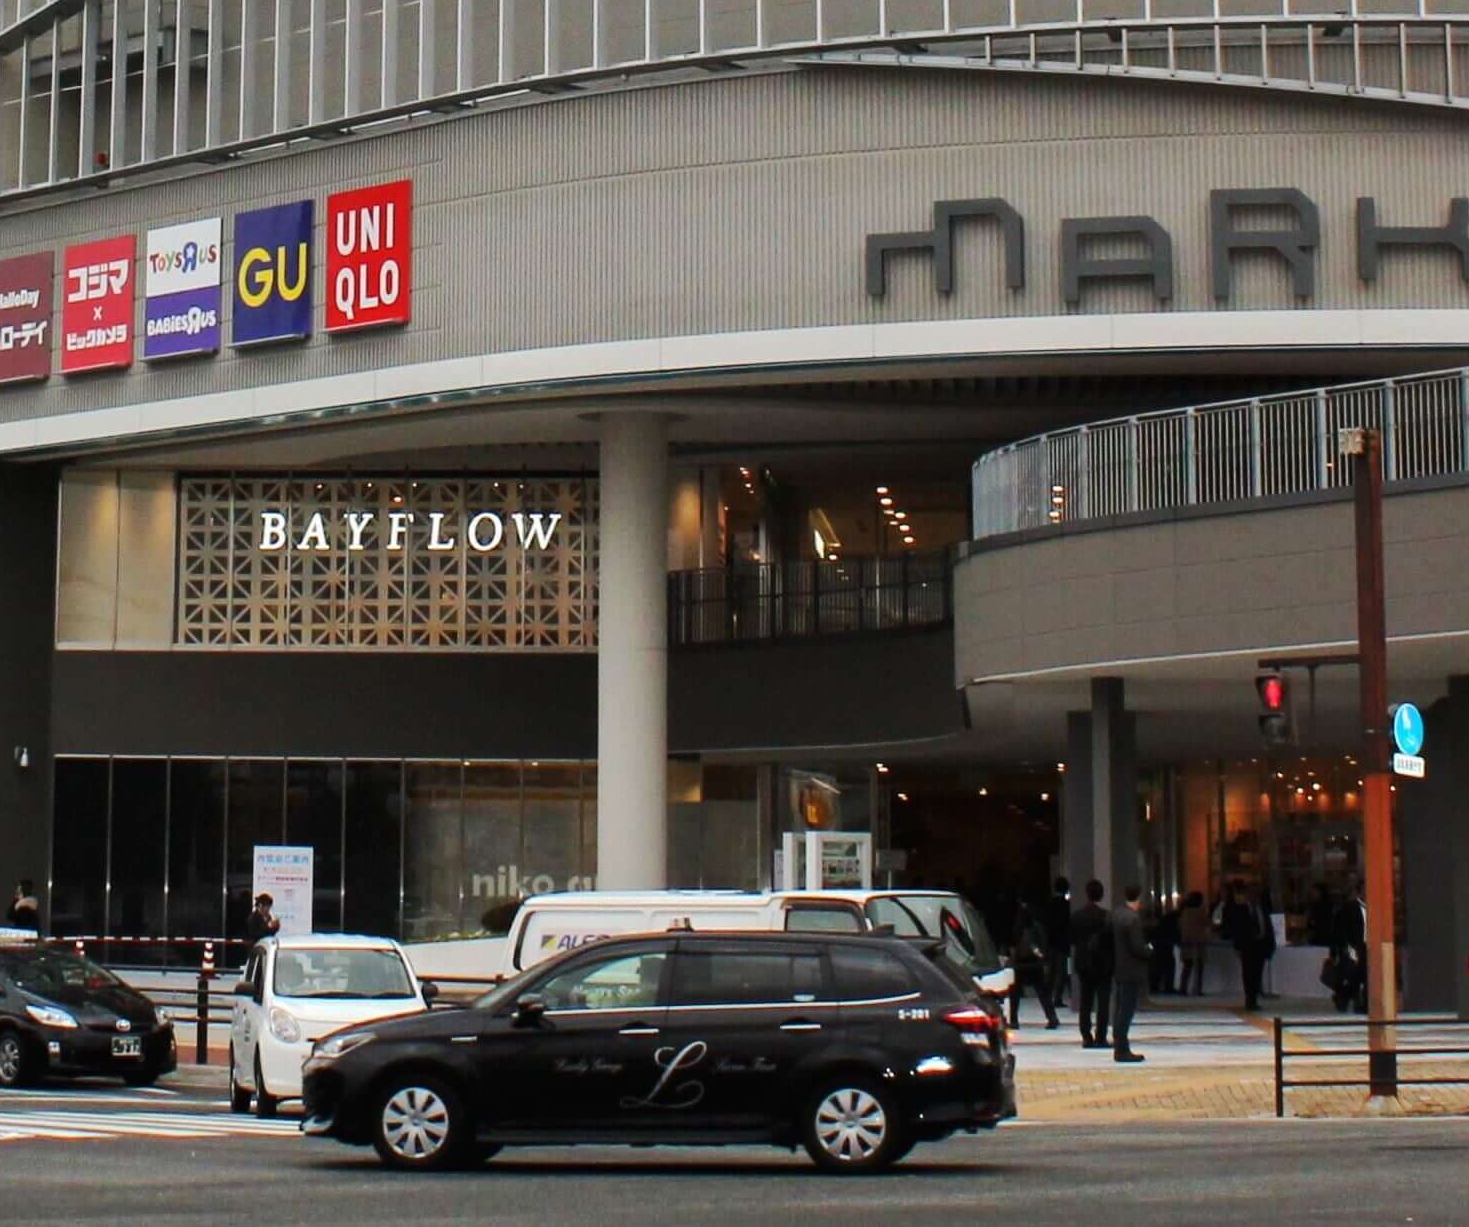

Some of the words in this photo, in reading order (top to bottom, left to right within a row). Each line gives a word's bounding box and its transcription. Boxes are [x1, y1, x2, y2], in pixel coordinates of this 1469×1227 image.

[336, 202, 395, 256] UNI
[67, 258, 130, 303] コジマ
[238, 242, 308, 308] GU
[335, 259, 400, 320] QLO
[66, 324, 127, 352] ビックカメラ
[259, 511, 562, 551] BAYFLOW
[472, 865, 555, 897] niko
